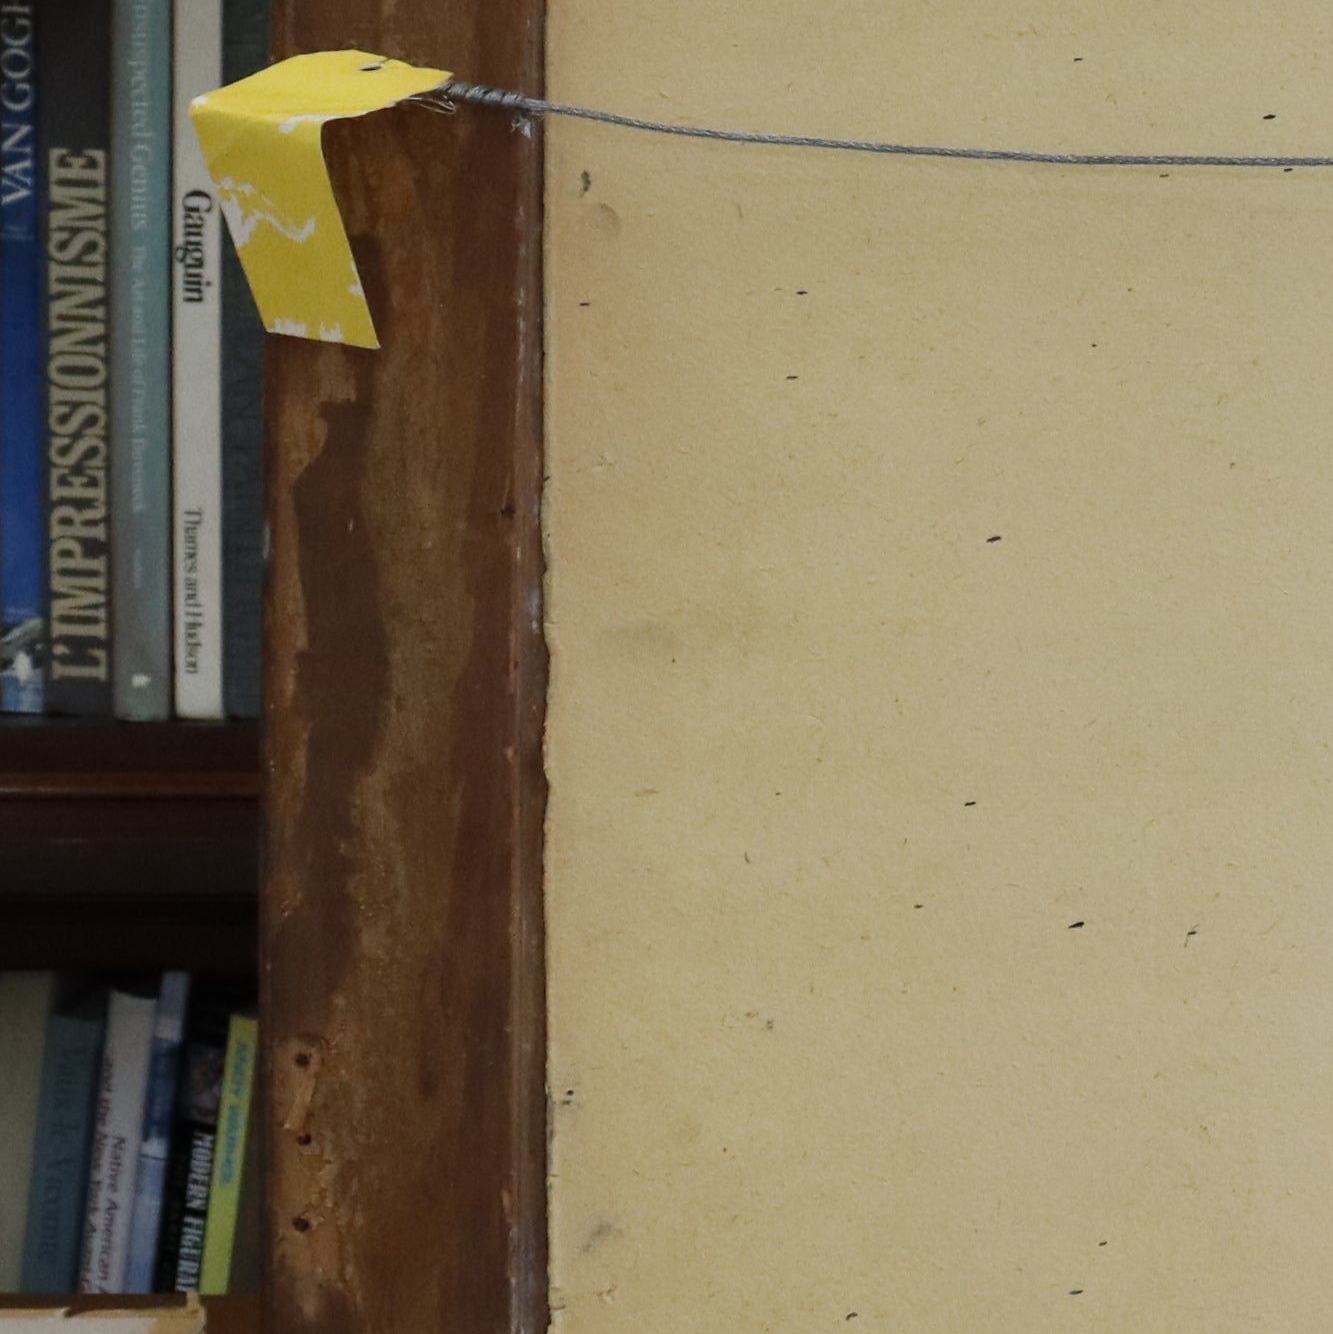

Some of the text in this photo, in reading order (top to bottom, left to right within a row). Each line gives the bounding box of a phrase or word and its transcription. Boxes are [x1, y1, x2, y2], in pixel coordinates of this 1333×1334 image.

[1, 126, 34, 208] VAN
[131, 143, 153, 230] Genius
[175, 189, 213, 304] Gauguin
[48, 148, 107, 683] L'IMPRESSIONNISME
[183, 507, 204, 674] Thames and Hudson
[100, 1135, 127, 1280] Native American
[186, 1132, 215, 1211] MODERN
